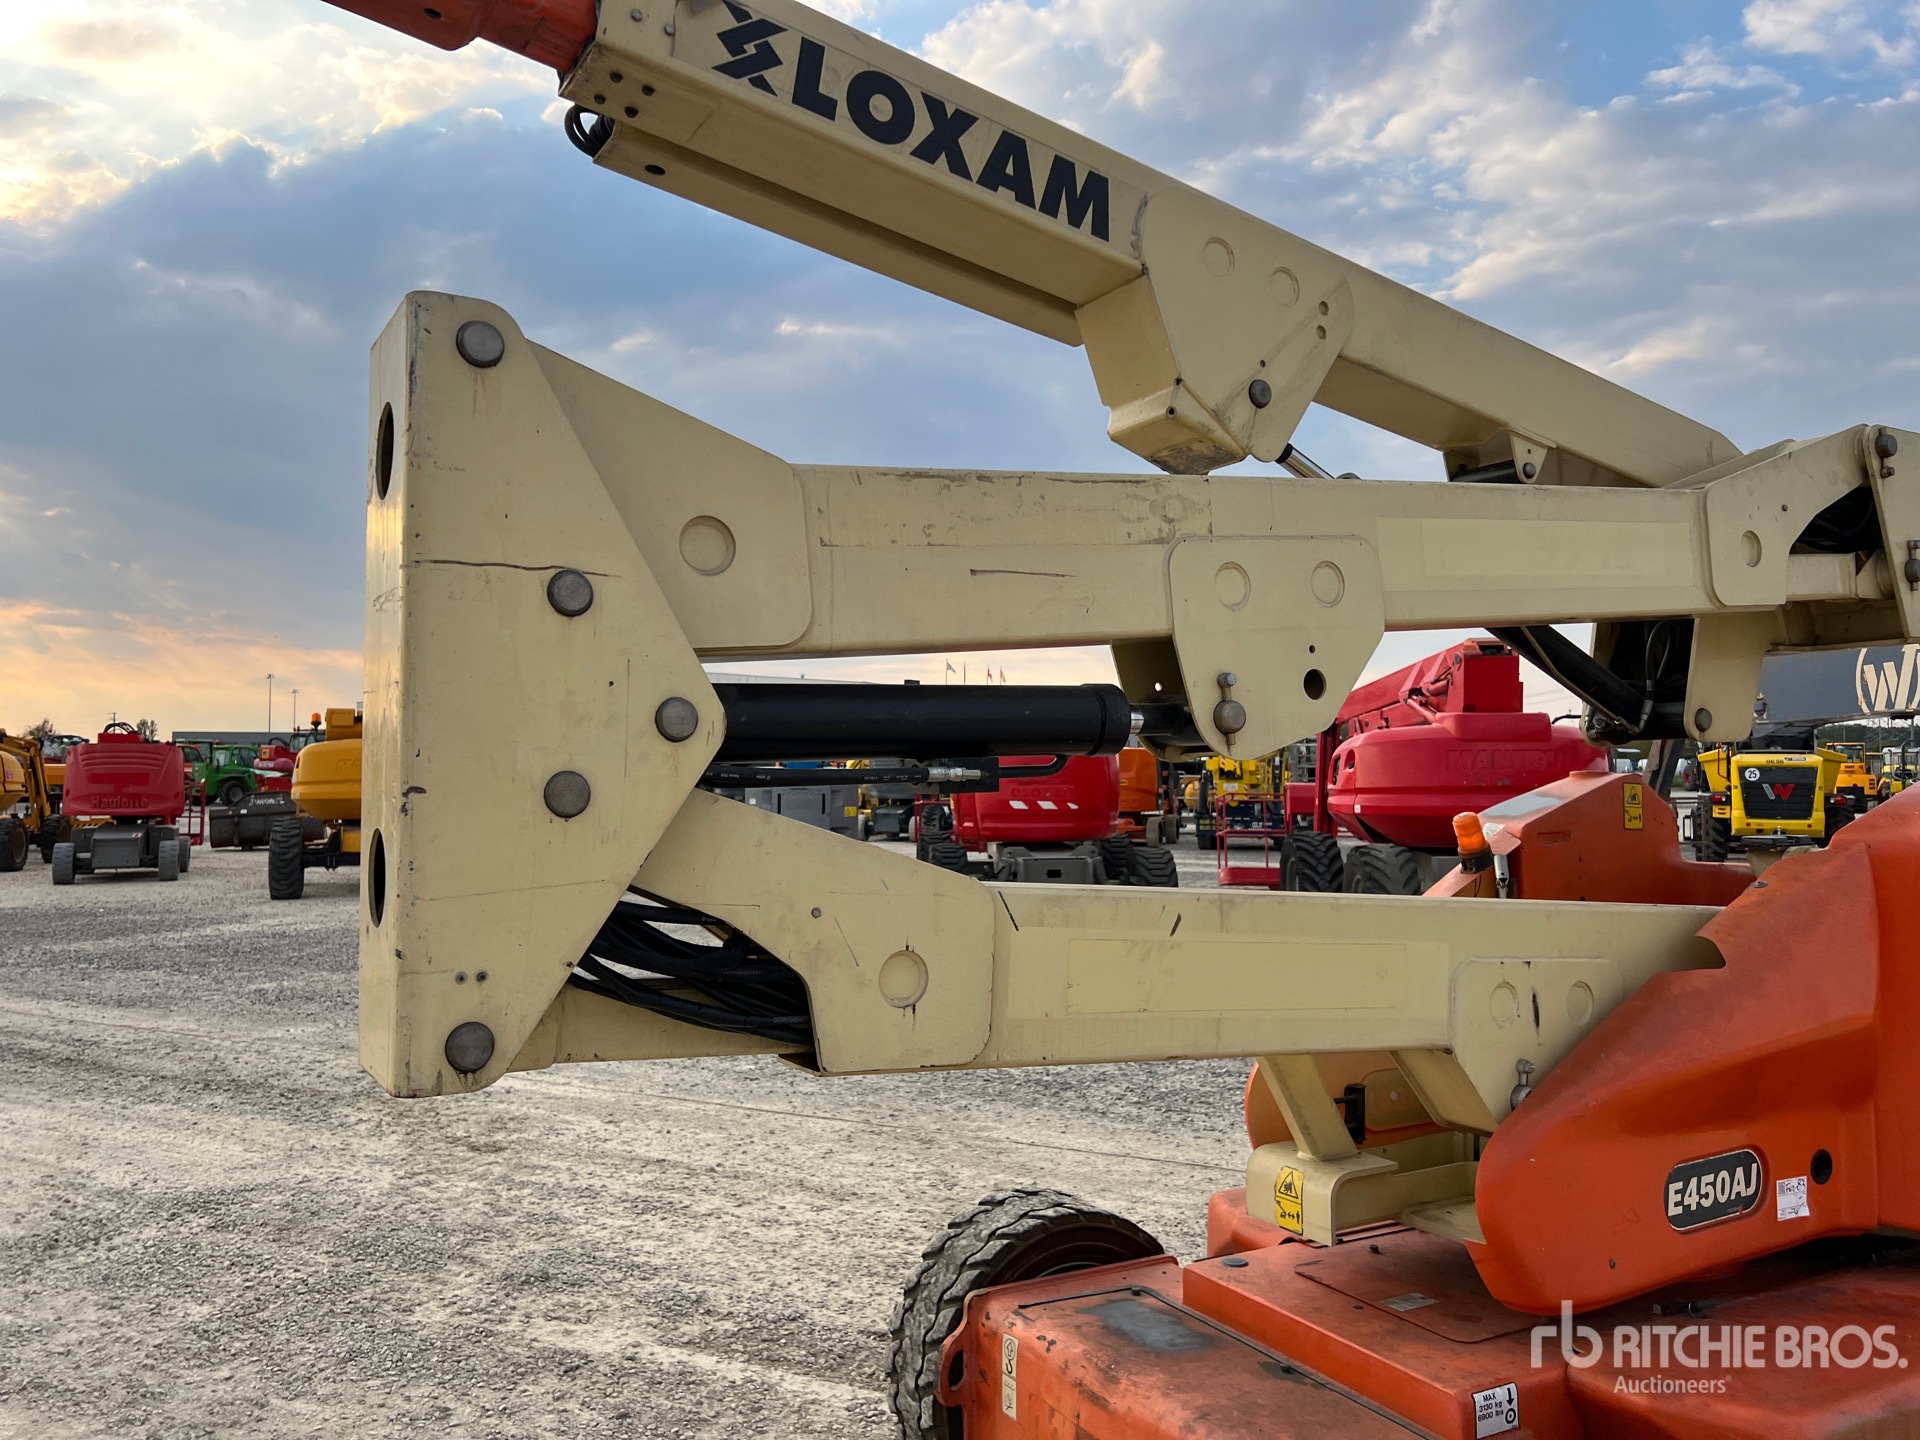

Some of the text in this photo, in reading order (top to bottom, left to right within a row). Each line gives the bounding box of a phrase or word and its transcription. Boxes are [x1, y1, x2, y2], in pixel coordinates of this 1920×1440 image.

[791, 36, 1109, 243] LOXAM
[1748, 770, 1757, 779] 25
[1668, 1163, 1758, 1217] E450AJ
[1483, 1393, 1496, 1402] MAX
[1479, 1403, 1493, 1412] 3130
[1478, 1411, 1493, 1421] 6900
